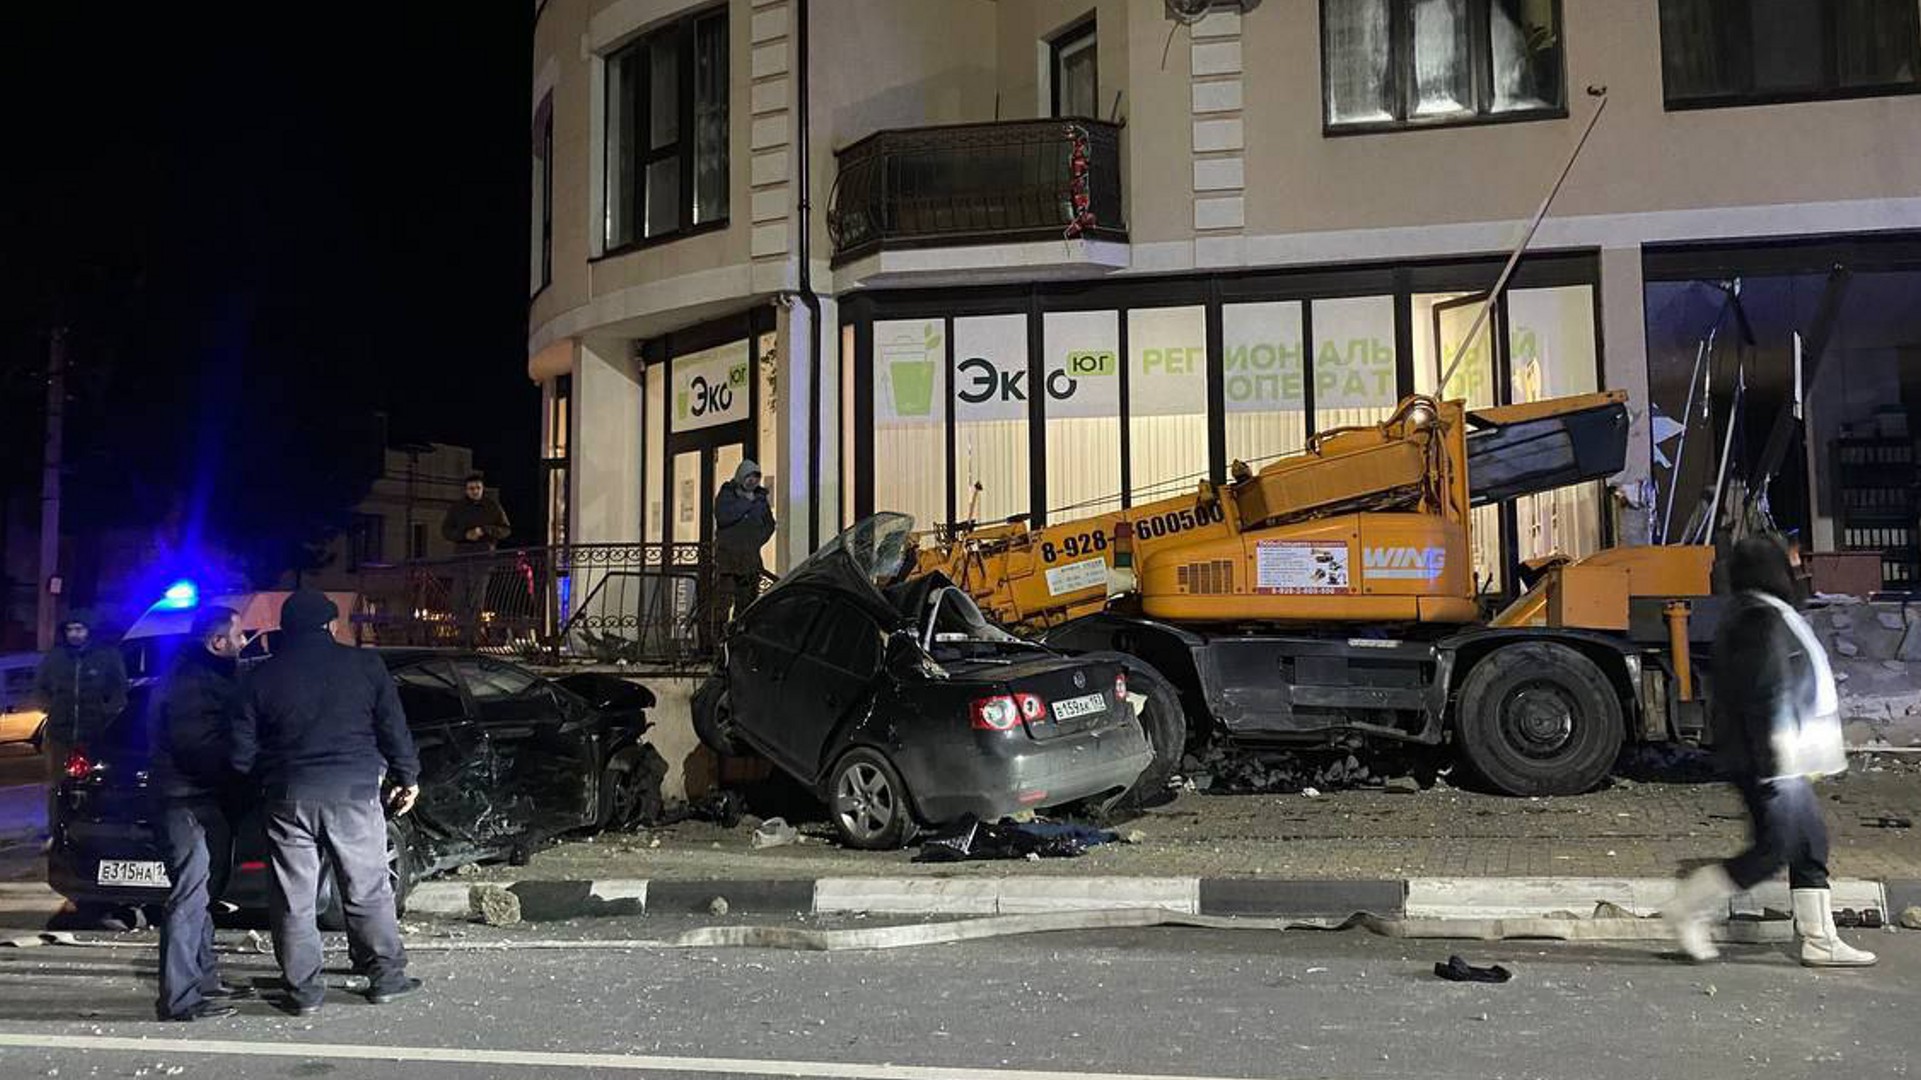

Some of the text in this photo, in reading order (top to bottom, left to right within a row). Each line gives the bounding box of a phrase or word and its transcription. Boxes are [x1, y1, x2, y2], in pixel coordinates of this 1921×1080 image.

[691, 376, 733, 417] Эко
[957, 356, 1109, 403] Эко ЮГ
[1363, 547, 1446, 569] WING
